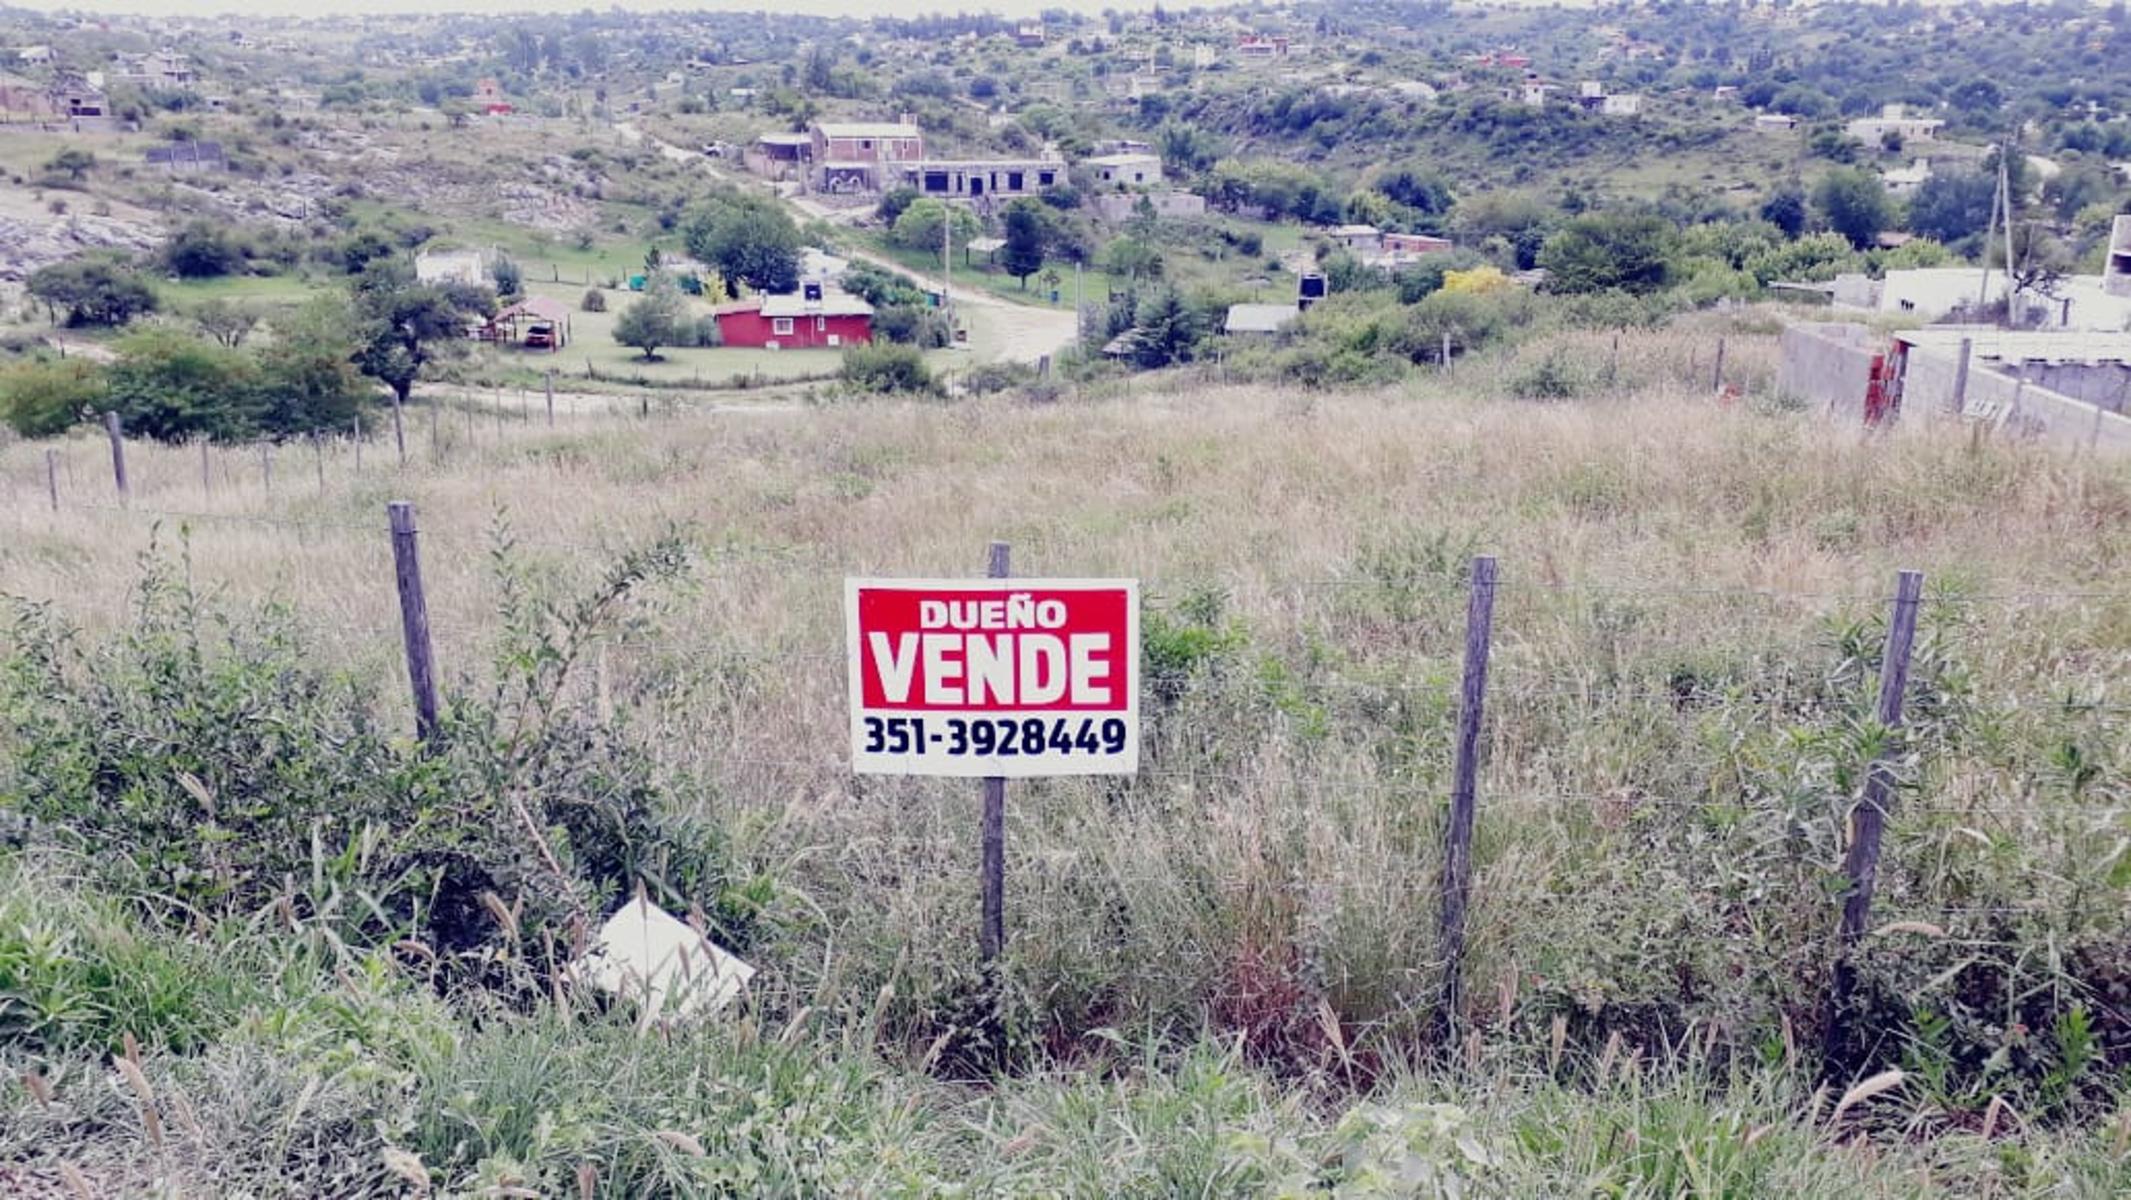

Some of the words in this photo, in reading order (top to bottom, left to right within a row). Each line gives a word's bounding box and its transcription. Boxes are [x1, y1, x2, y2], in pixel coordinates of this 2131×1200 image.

[920, 593, 1067, 629] DUEÑO
[868, 631, 1111, 705] VENDE
[864, 717, 1127, 756] 351-3928449
